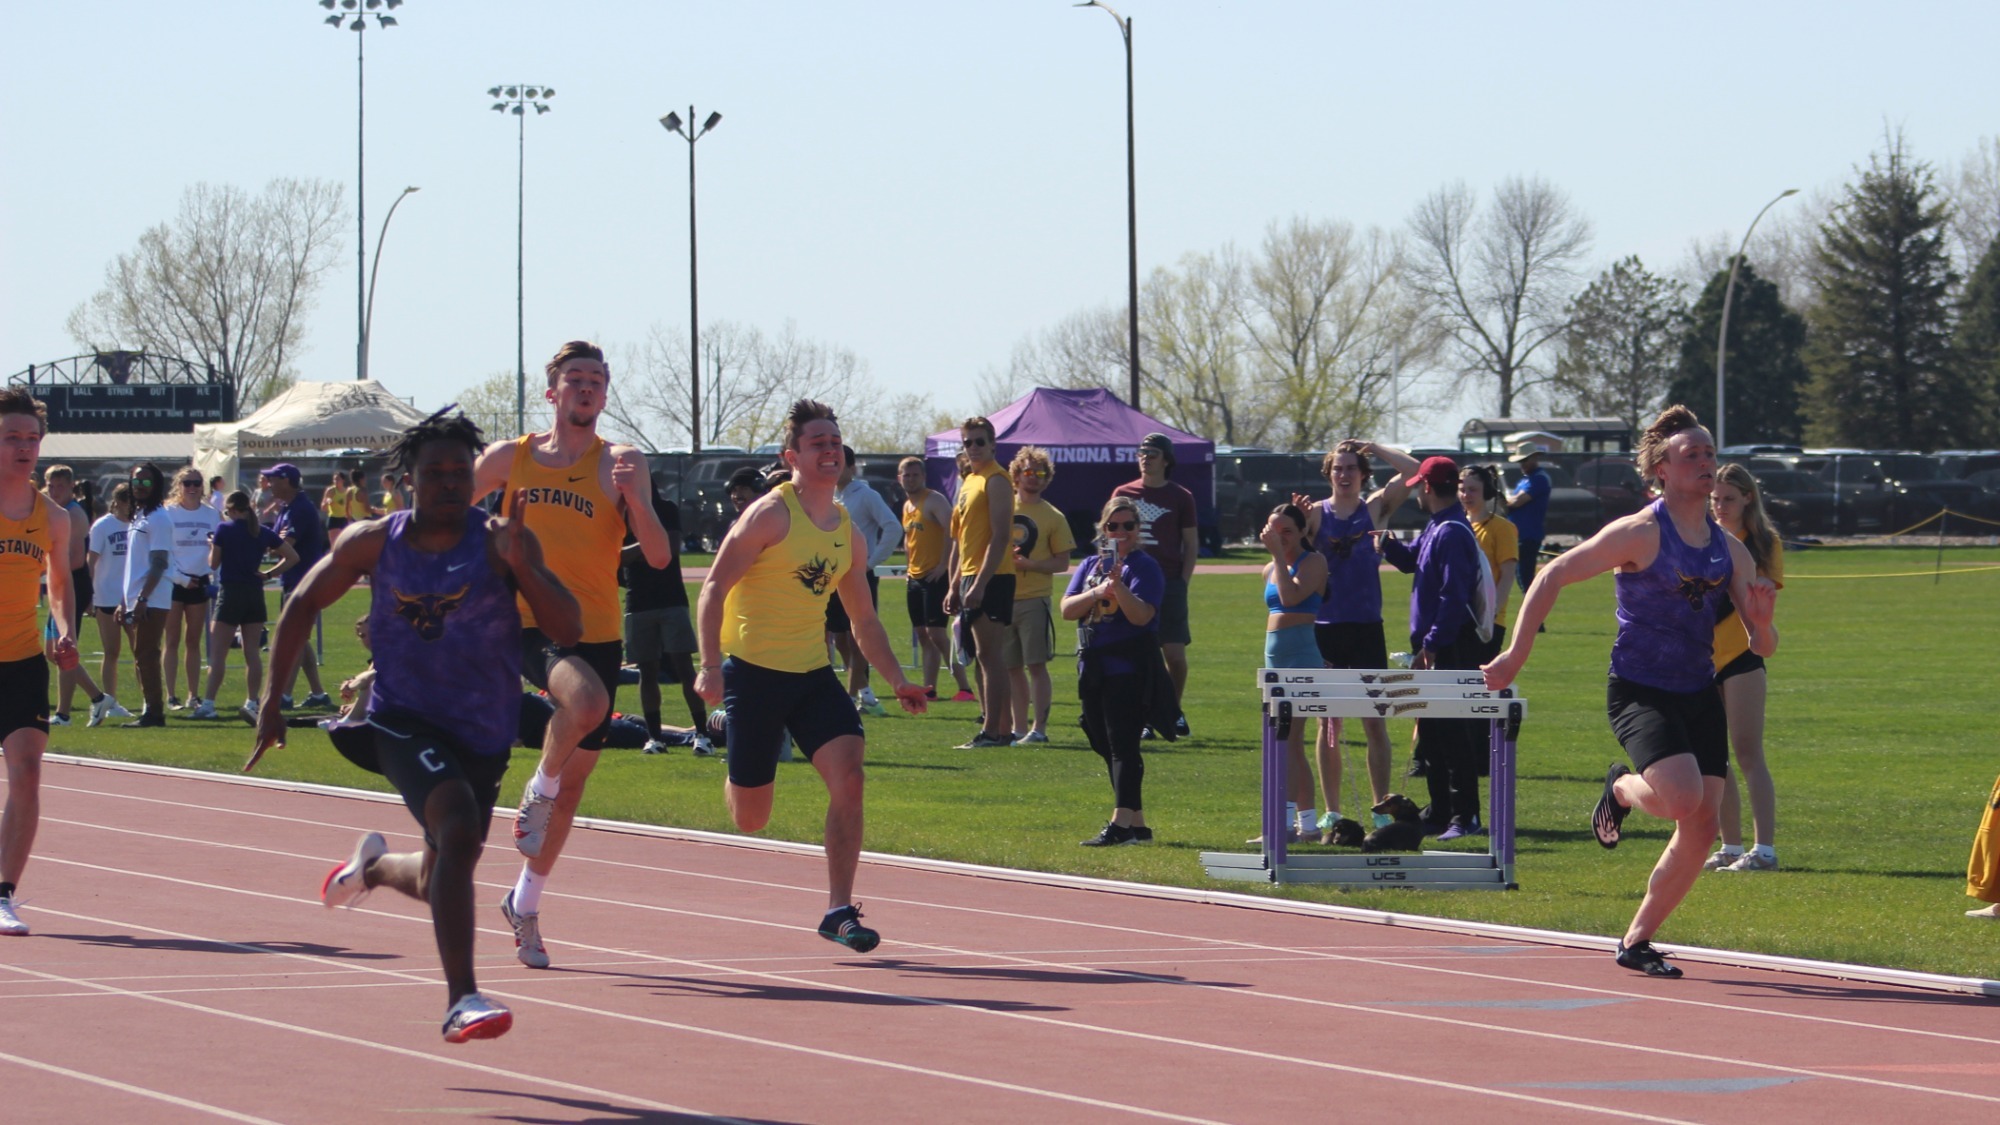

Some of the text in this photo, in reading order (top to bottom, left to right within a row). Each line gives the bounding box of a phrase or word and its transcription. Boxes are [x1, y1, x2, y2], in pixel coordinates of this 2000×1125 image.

[36, 387, 51, 396] BAT
[73, 387, 93, 396] BALL
[107, 387, 135, 396] STRIKE
[150, 387, 166, 396] OUT
[242, 438, 307, 449] SOUTHWEST
[312, 435, 377, 446] MINNESOTA
[525, 488, 594, 518] STAVUS
[0, 540, 44, 563] STAVUS
[419, 748, 445, 772] C
[1366, 857, 1400, 866] UCS
[1372, 872, 1406, 880] UCS
